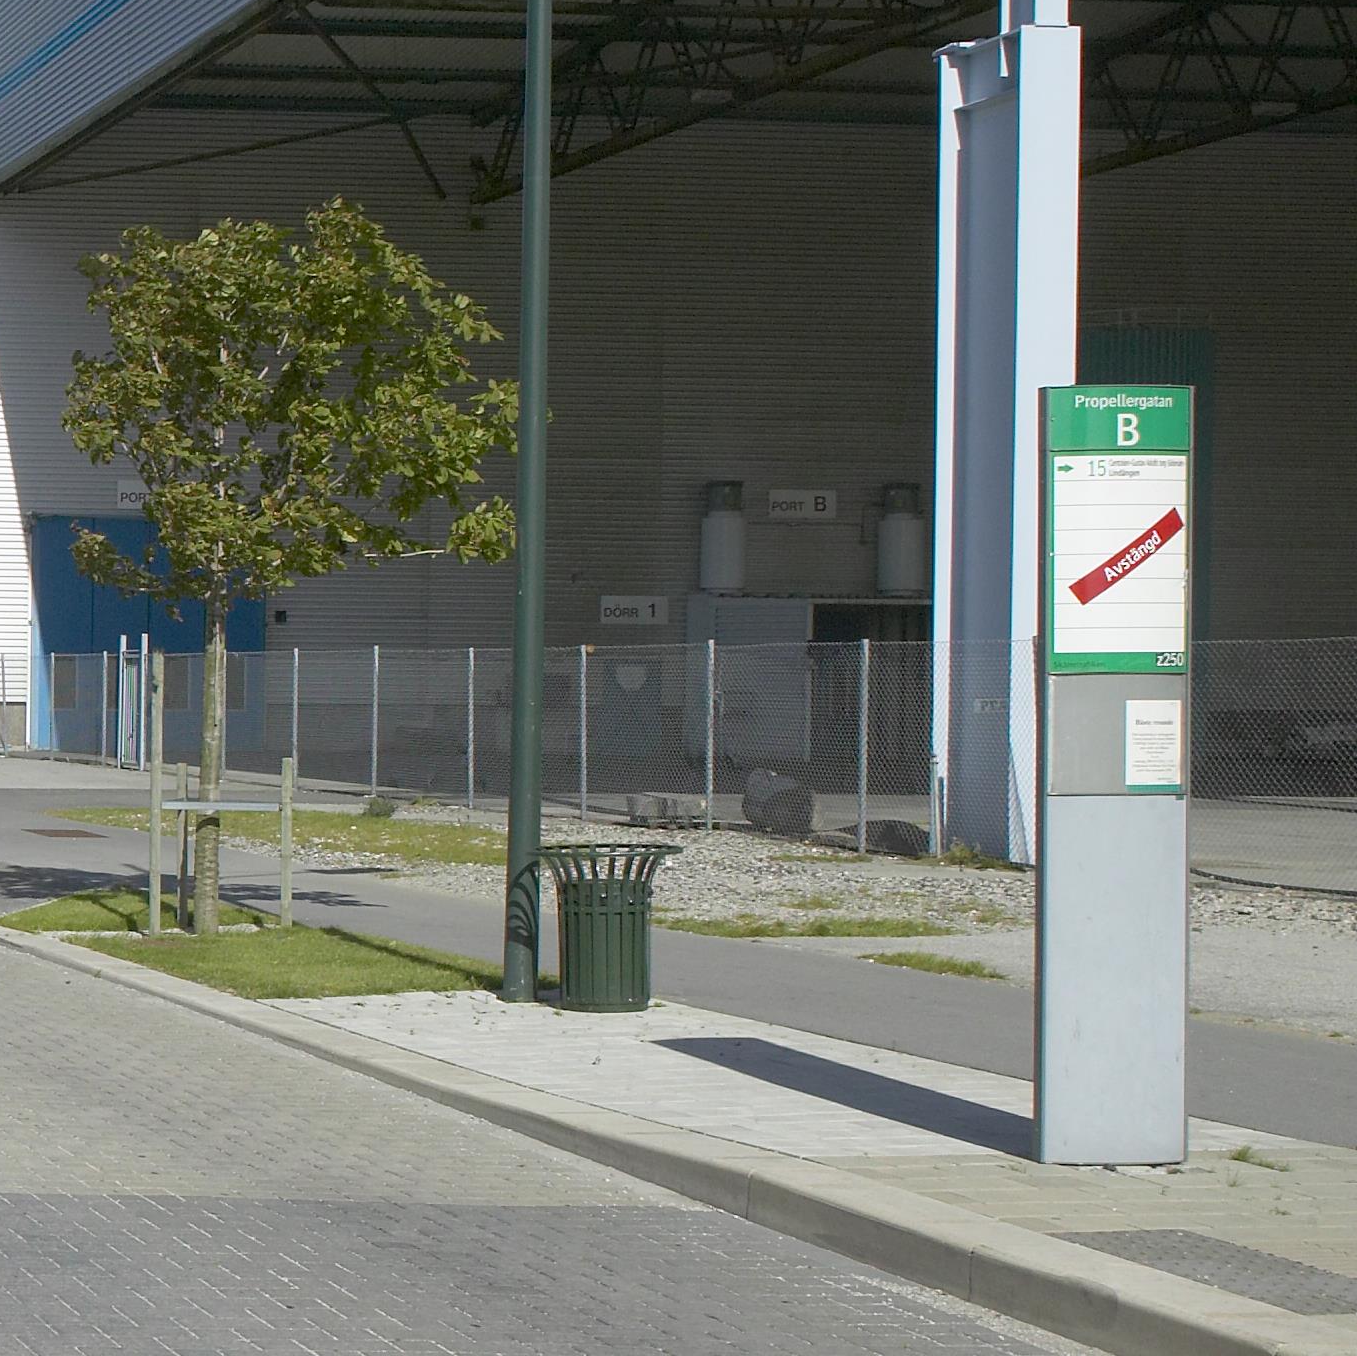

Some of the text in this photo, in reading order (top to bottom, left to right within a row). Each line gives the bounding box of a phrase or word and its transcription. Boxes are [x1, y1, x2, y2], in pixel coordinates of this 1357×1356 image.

[1074, 393, 1174, 411] Propellergatan
[1116, 413, 1141, 447] B
[1087, 459, 1107, 477] 15
[771, 495, 828, 512] PORT B
[1102, 529, 1162, 582] Avstängd
[603, 603, 656, 618] DÖRR 1
